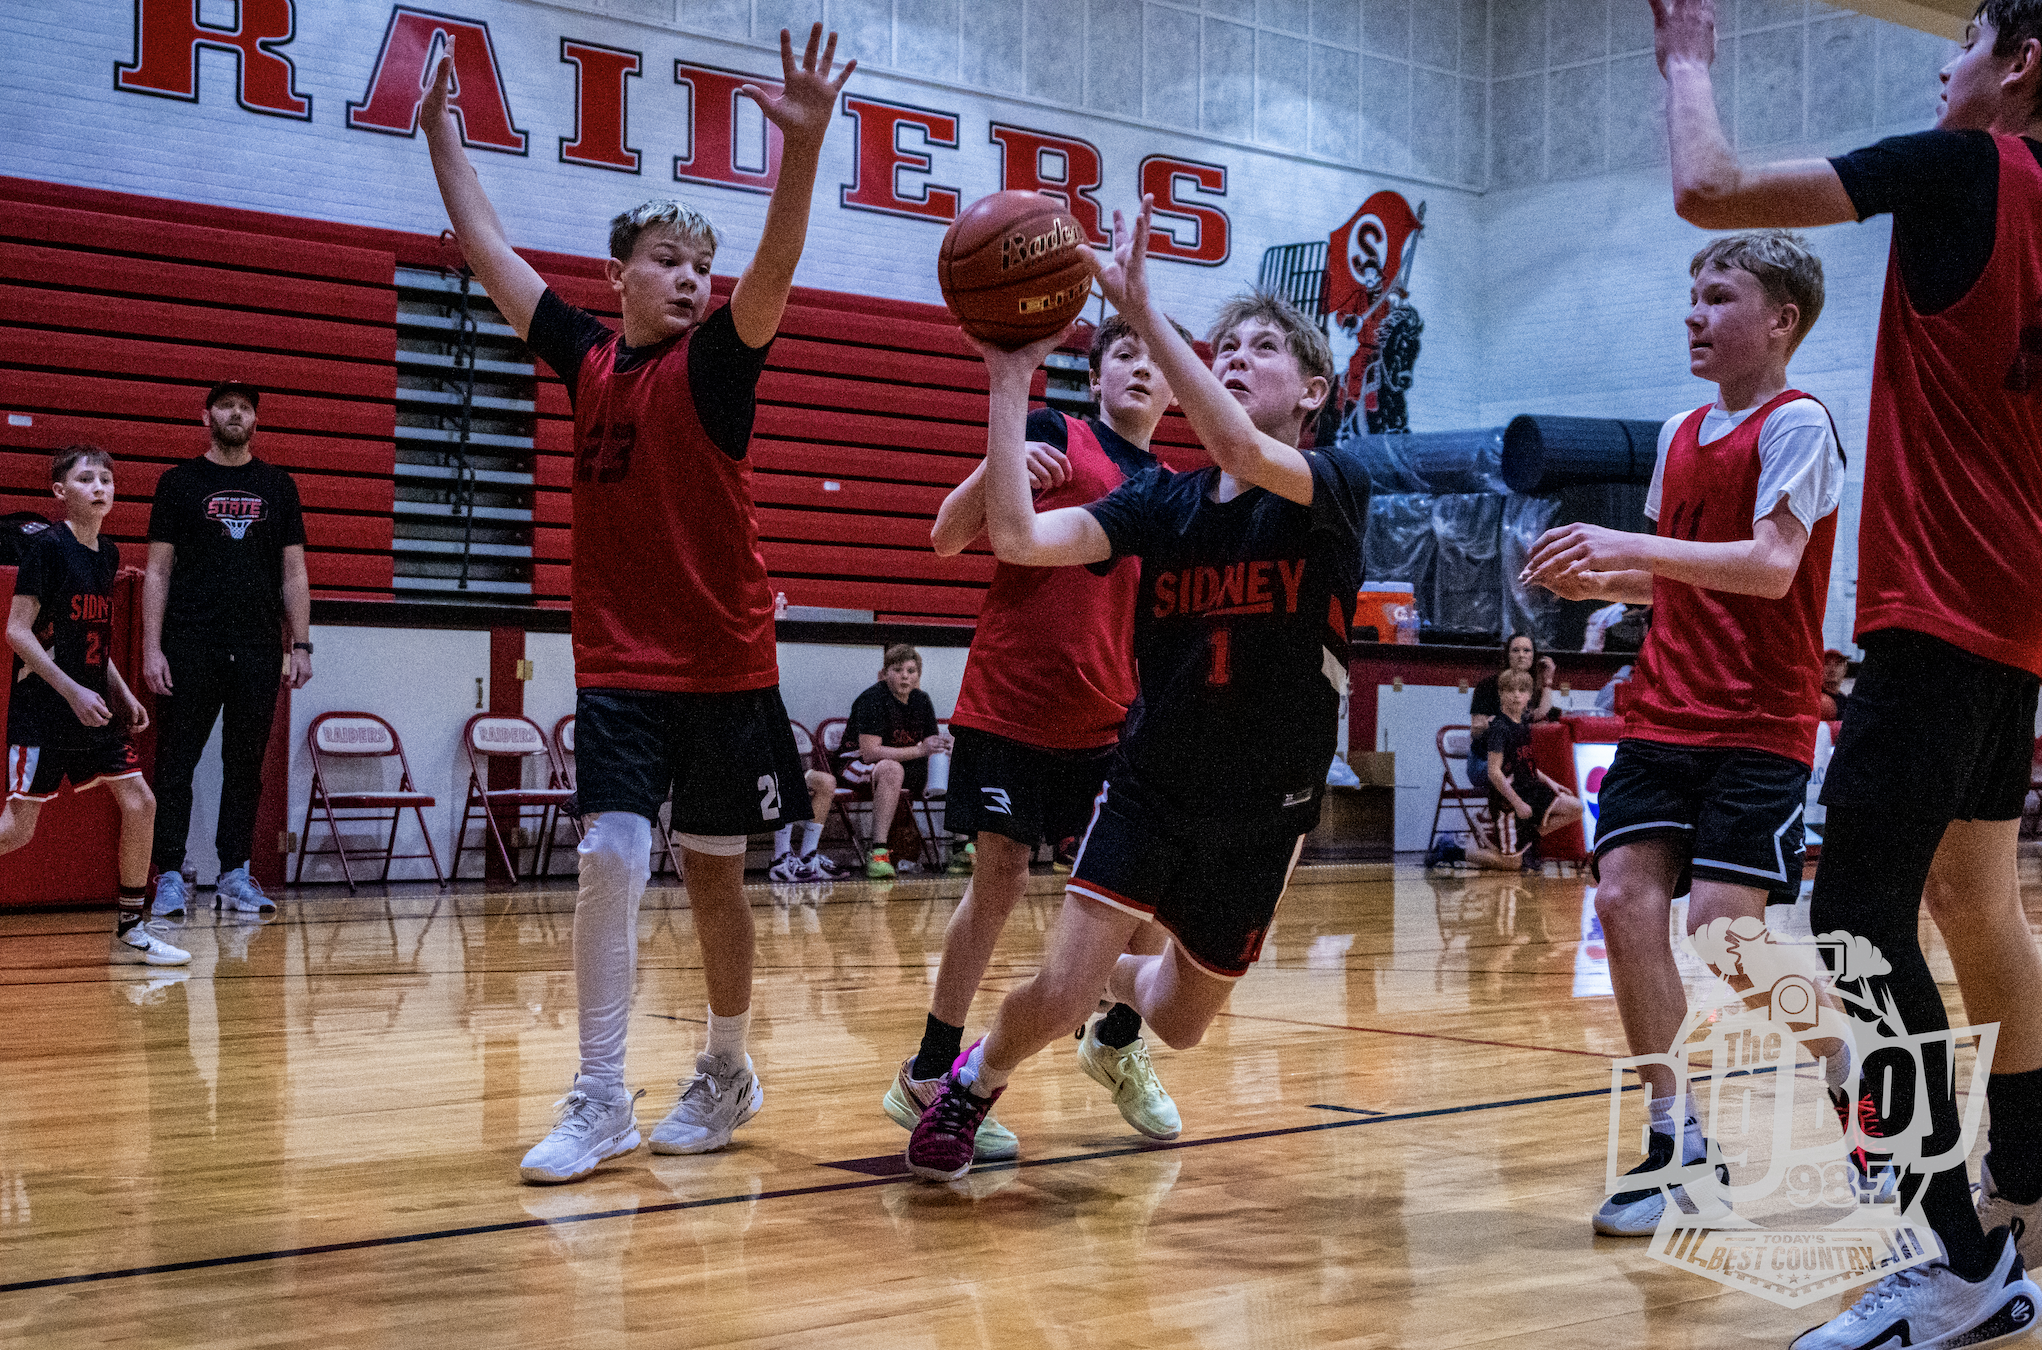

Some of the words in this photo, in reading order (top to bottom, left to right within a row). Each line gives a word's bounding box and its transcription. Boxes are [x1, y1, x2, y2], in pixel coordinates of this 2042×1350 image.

[114, 0, 1232, 267] RAIDERS
[207, 500, 262, 515] STATE
[1153, 558, 1306, 618] SIDNEY
[1207, 628, 1231, 686] 1
[323, 727, 387, 743] RAIDERS
[477, 727, 537, 743] RAIDERS
